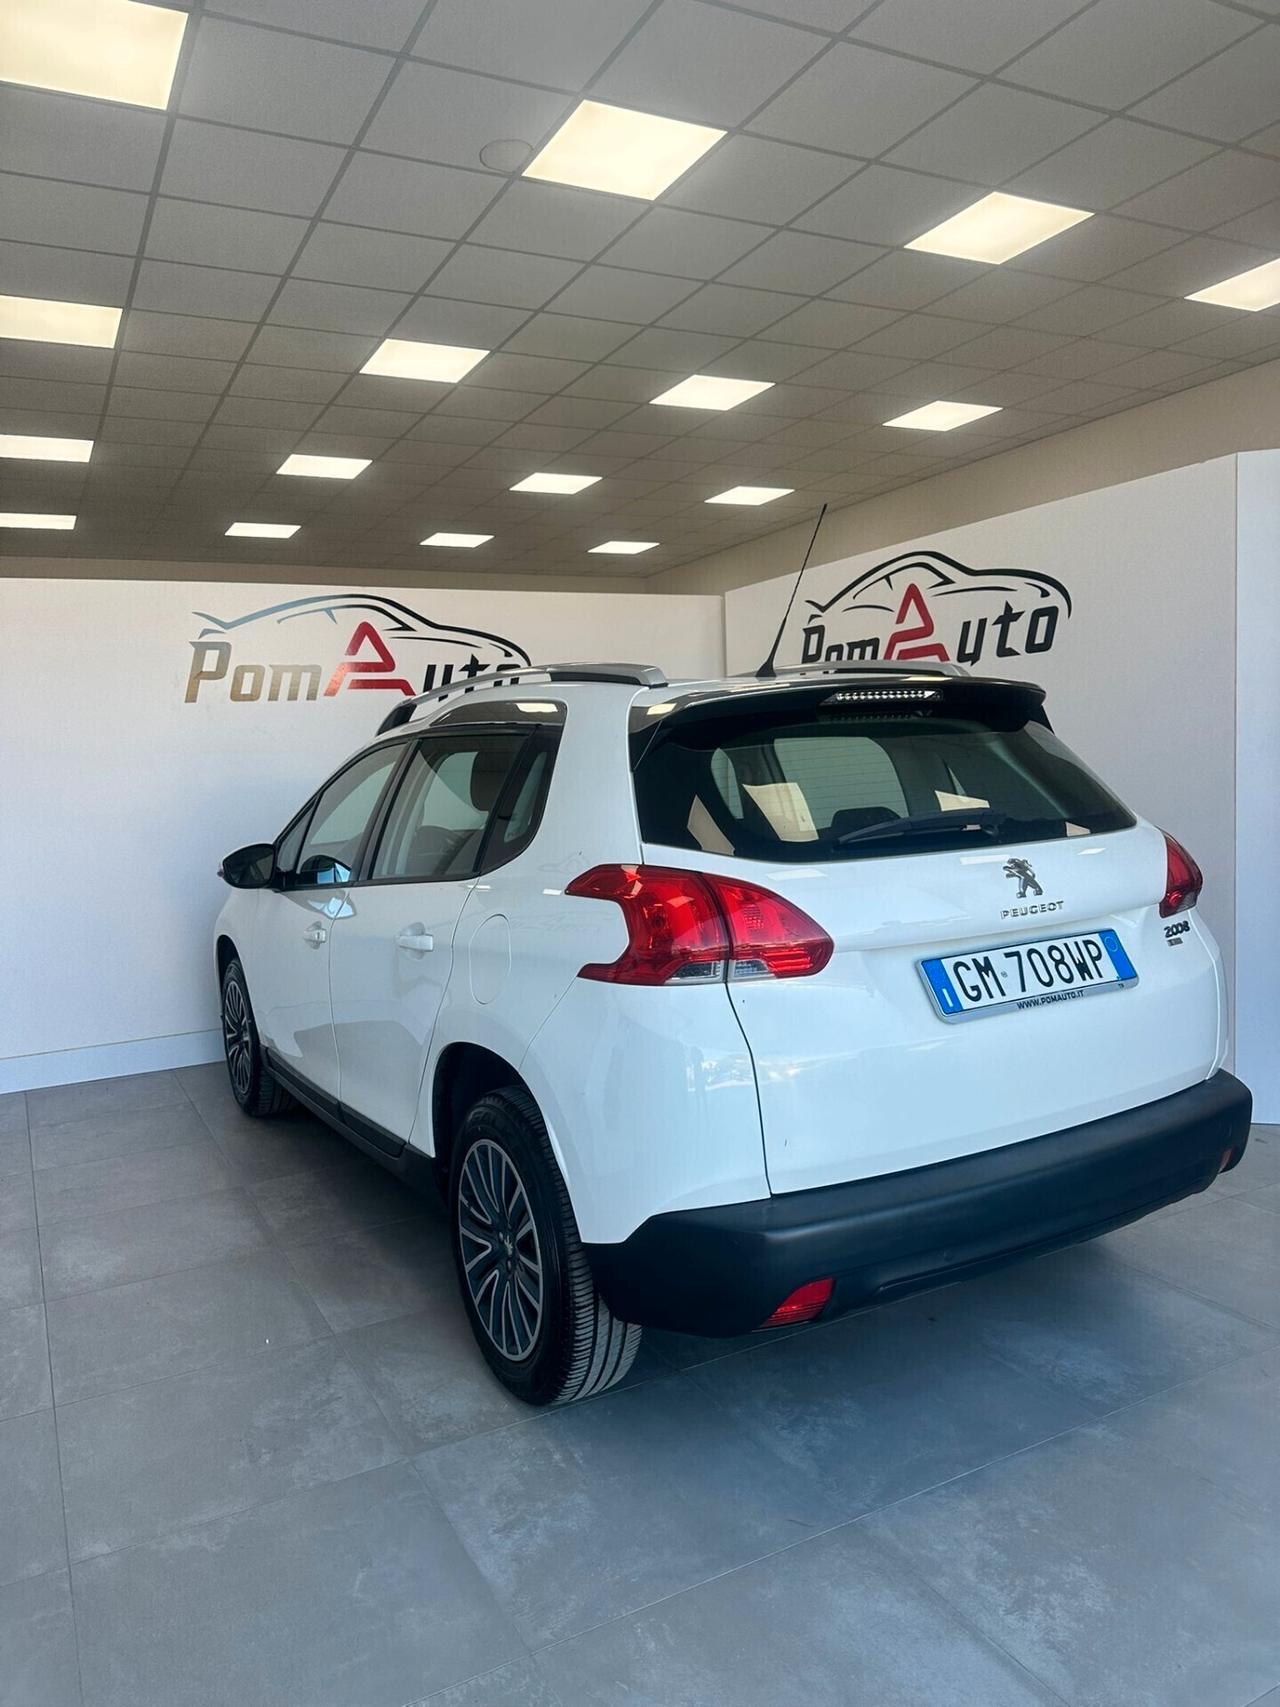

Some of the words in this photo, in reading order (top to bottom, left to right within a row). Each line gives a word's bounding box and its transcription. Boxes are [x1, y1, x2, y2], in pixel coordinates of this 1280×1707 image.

[1000, 900, 1064, 919] PEUGEOT
[1163, 920, 1190, 938] 2008
[1017, 989, 1085, 1010] WWW.POMAUTO.IT
